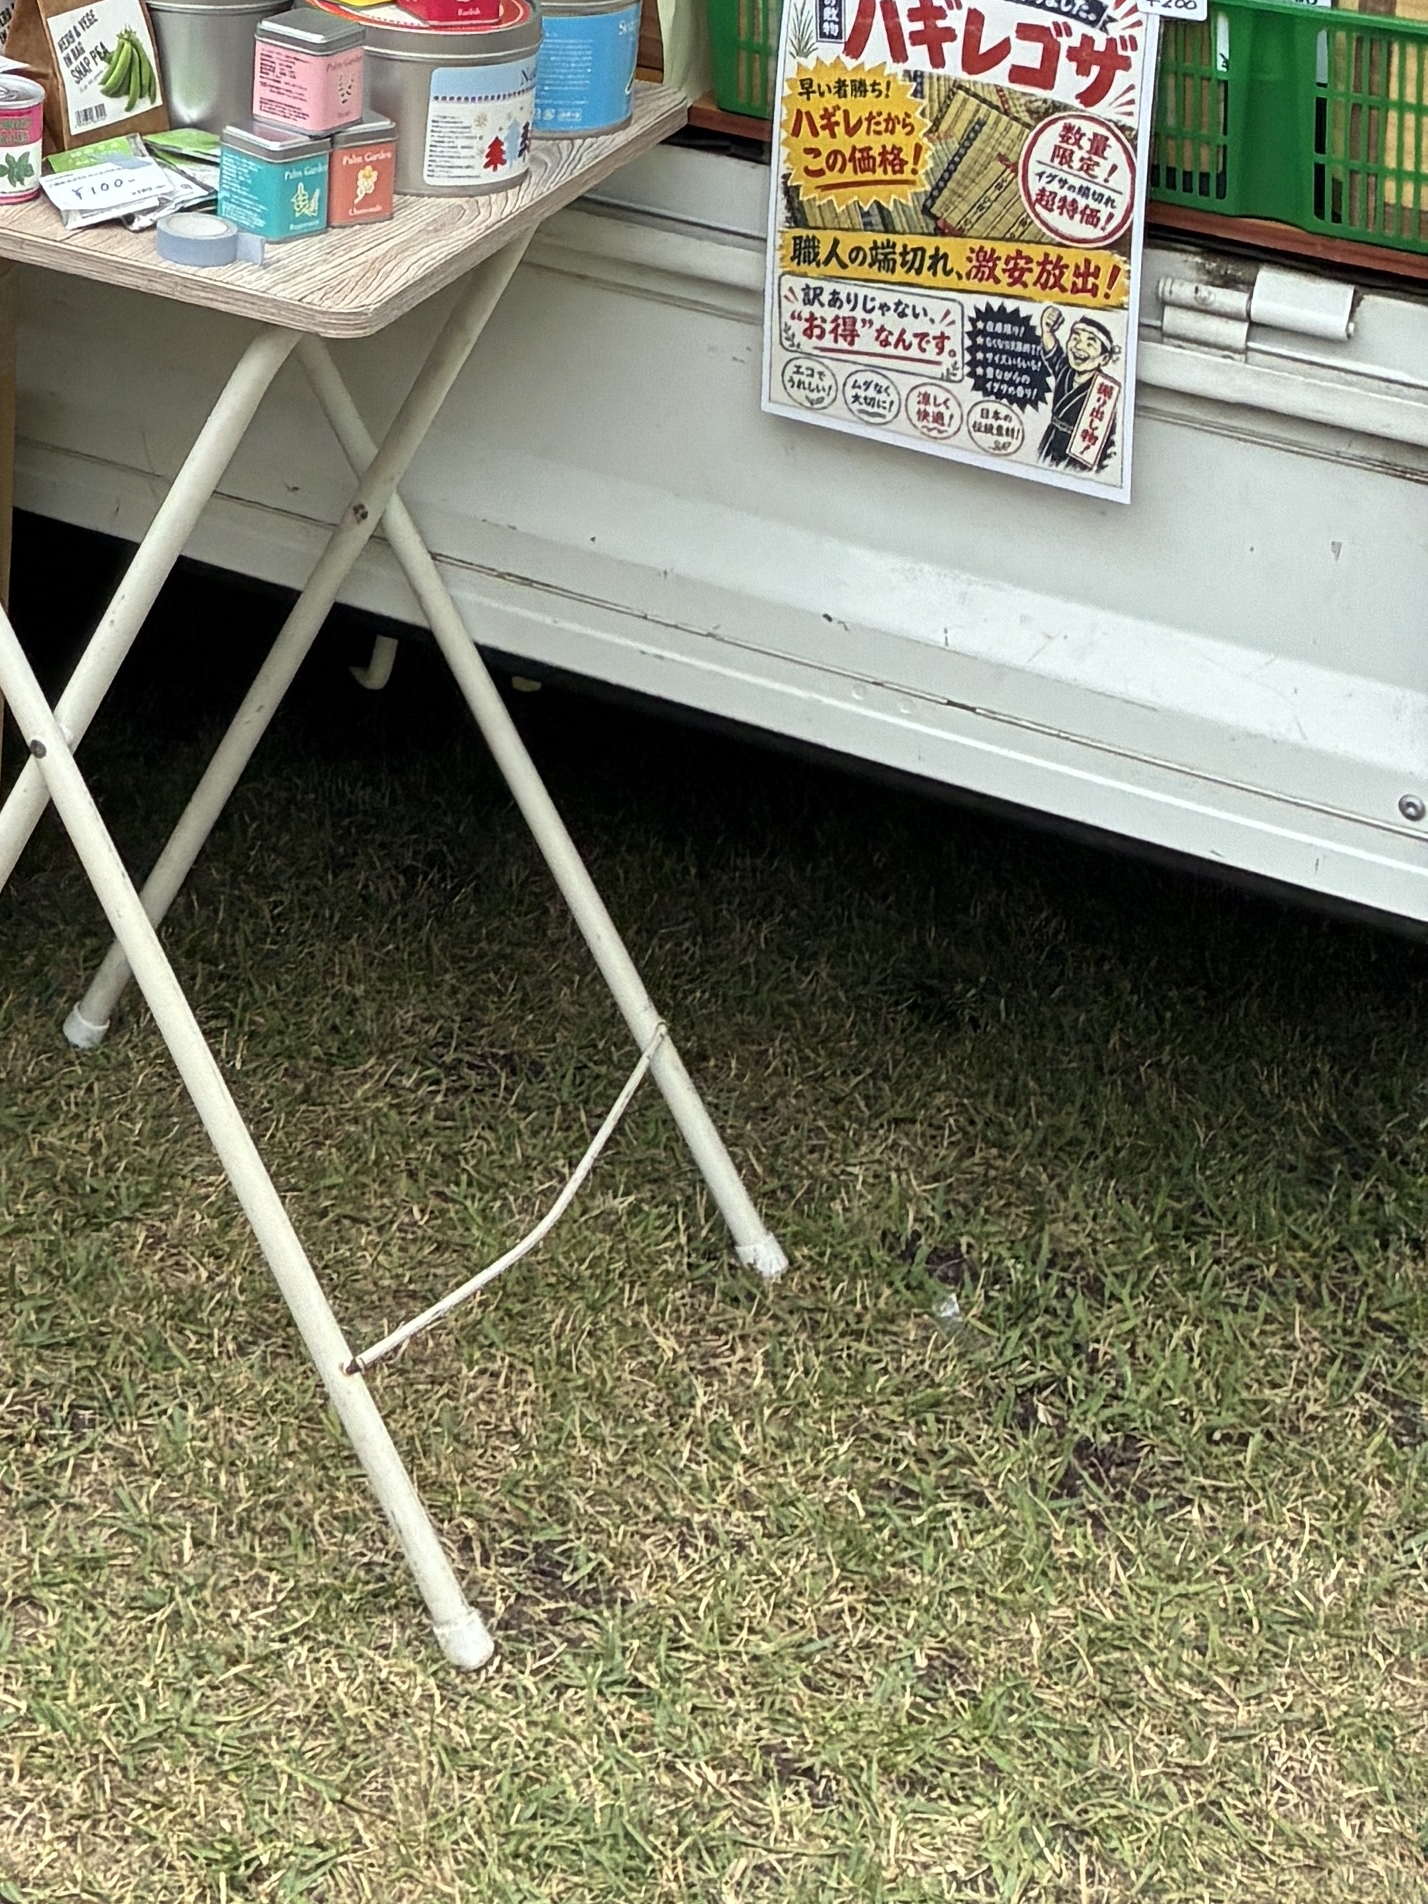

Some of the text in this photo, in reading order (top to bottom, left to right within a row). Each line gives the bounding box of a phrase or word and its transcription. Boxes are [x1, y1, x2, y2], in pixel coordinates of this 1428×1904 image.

[798, 78, 891, 100] 早い者勝ち!
[790, 105, 916, 139] ハギレだから
[1057, 121, 1114, 161] 数量
[802, 144, 922, 178] この価格!
[1050, 145, 1119, 184] 限定!
[1035, 186, 1115, 233] 超特価!
[801, 283, 936, 324] 訳ありじゃない、
[787, 377, 833, 397] うれしい!
[793, 364, 826, 382] エコで
[850, 393, 894, 413] 大切に!
